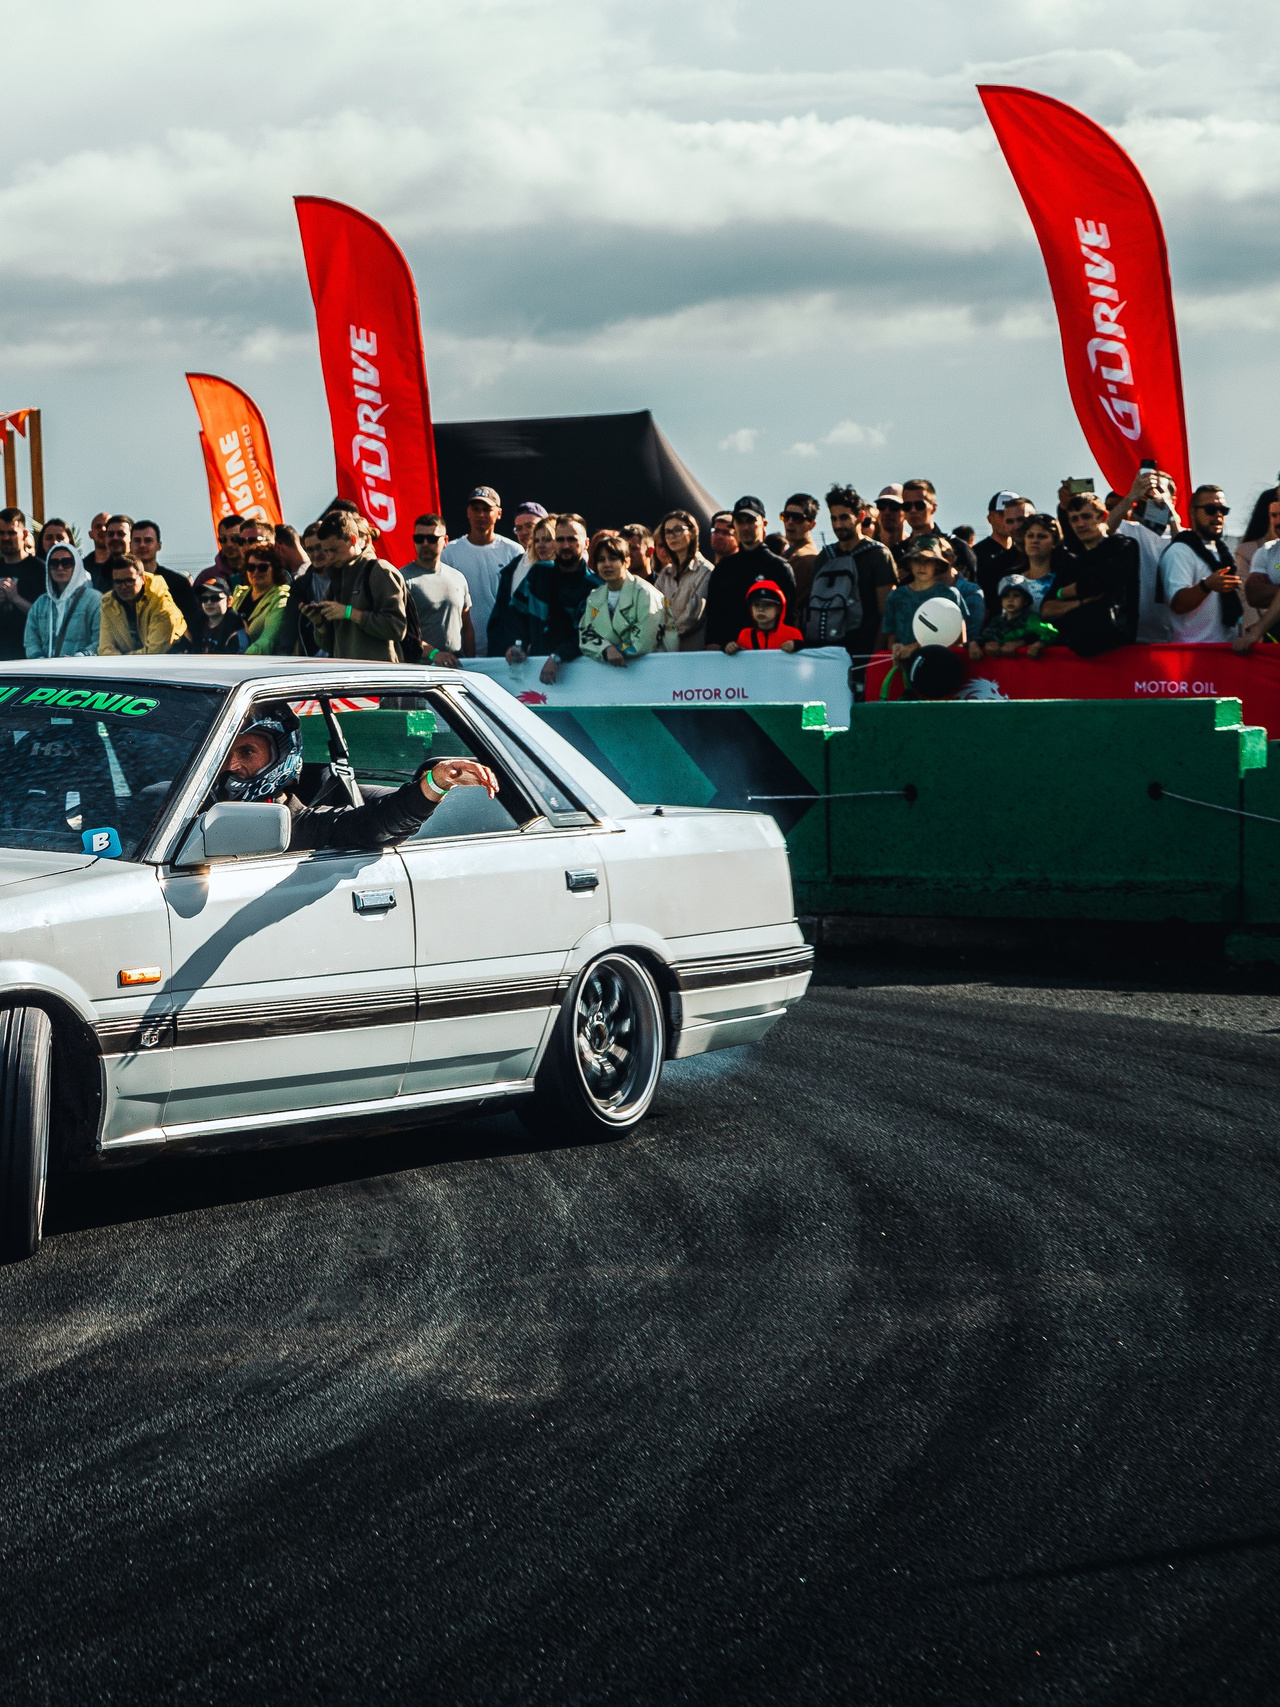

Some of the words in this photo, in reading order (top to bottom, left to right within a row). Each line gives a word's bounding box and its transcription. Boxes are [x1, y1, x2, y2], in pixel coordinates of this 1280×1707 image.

[672, 688, 722, 701] MOTOR
[725, 687, 749, 700] OIL
[1134, 681, 1188, 694] MOTOR
[1192, 681, 1218, 694] OIL
[21, 687, 158, 716] PICNIC
[92, 832, 111, 852] B
